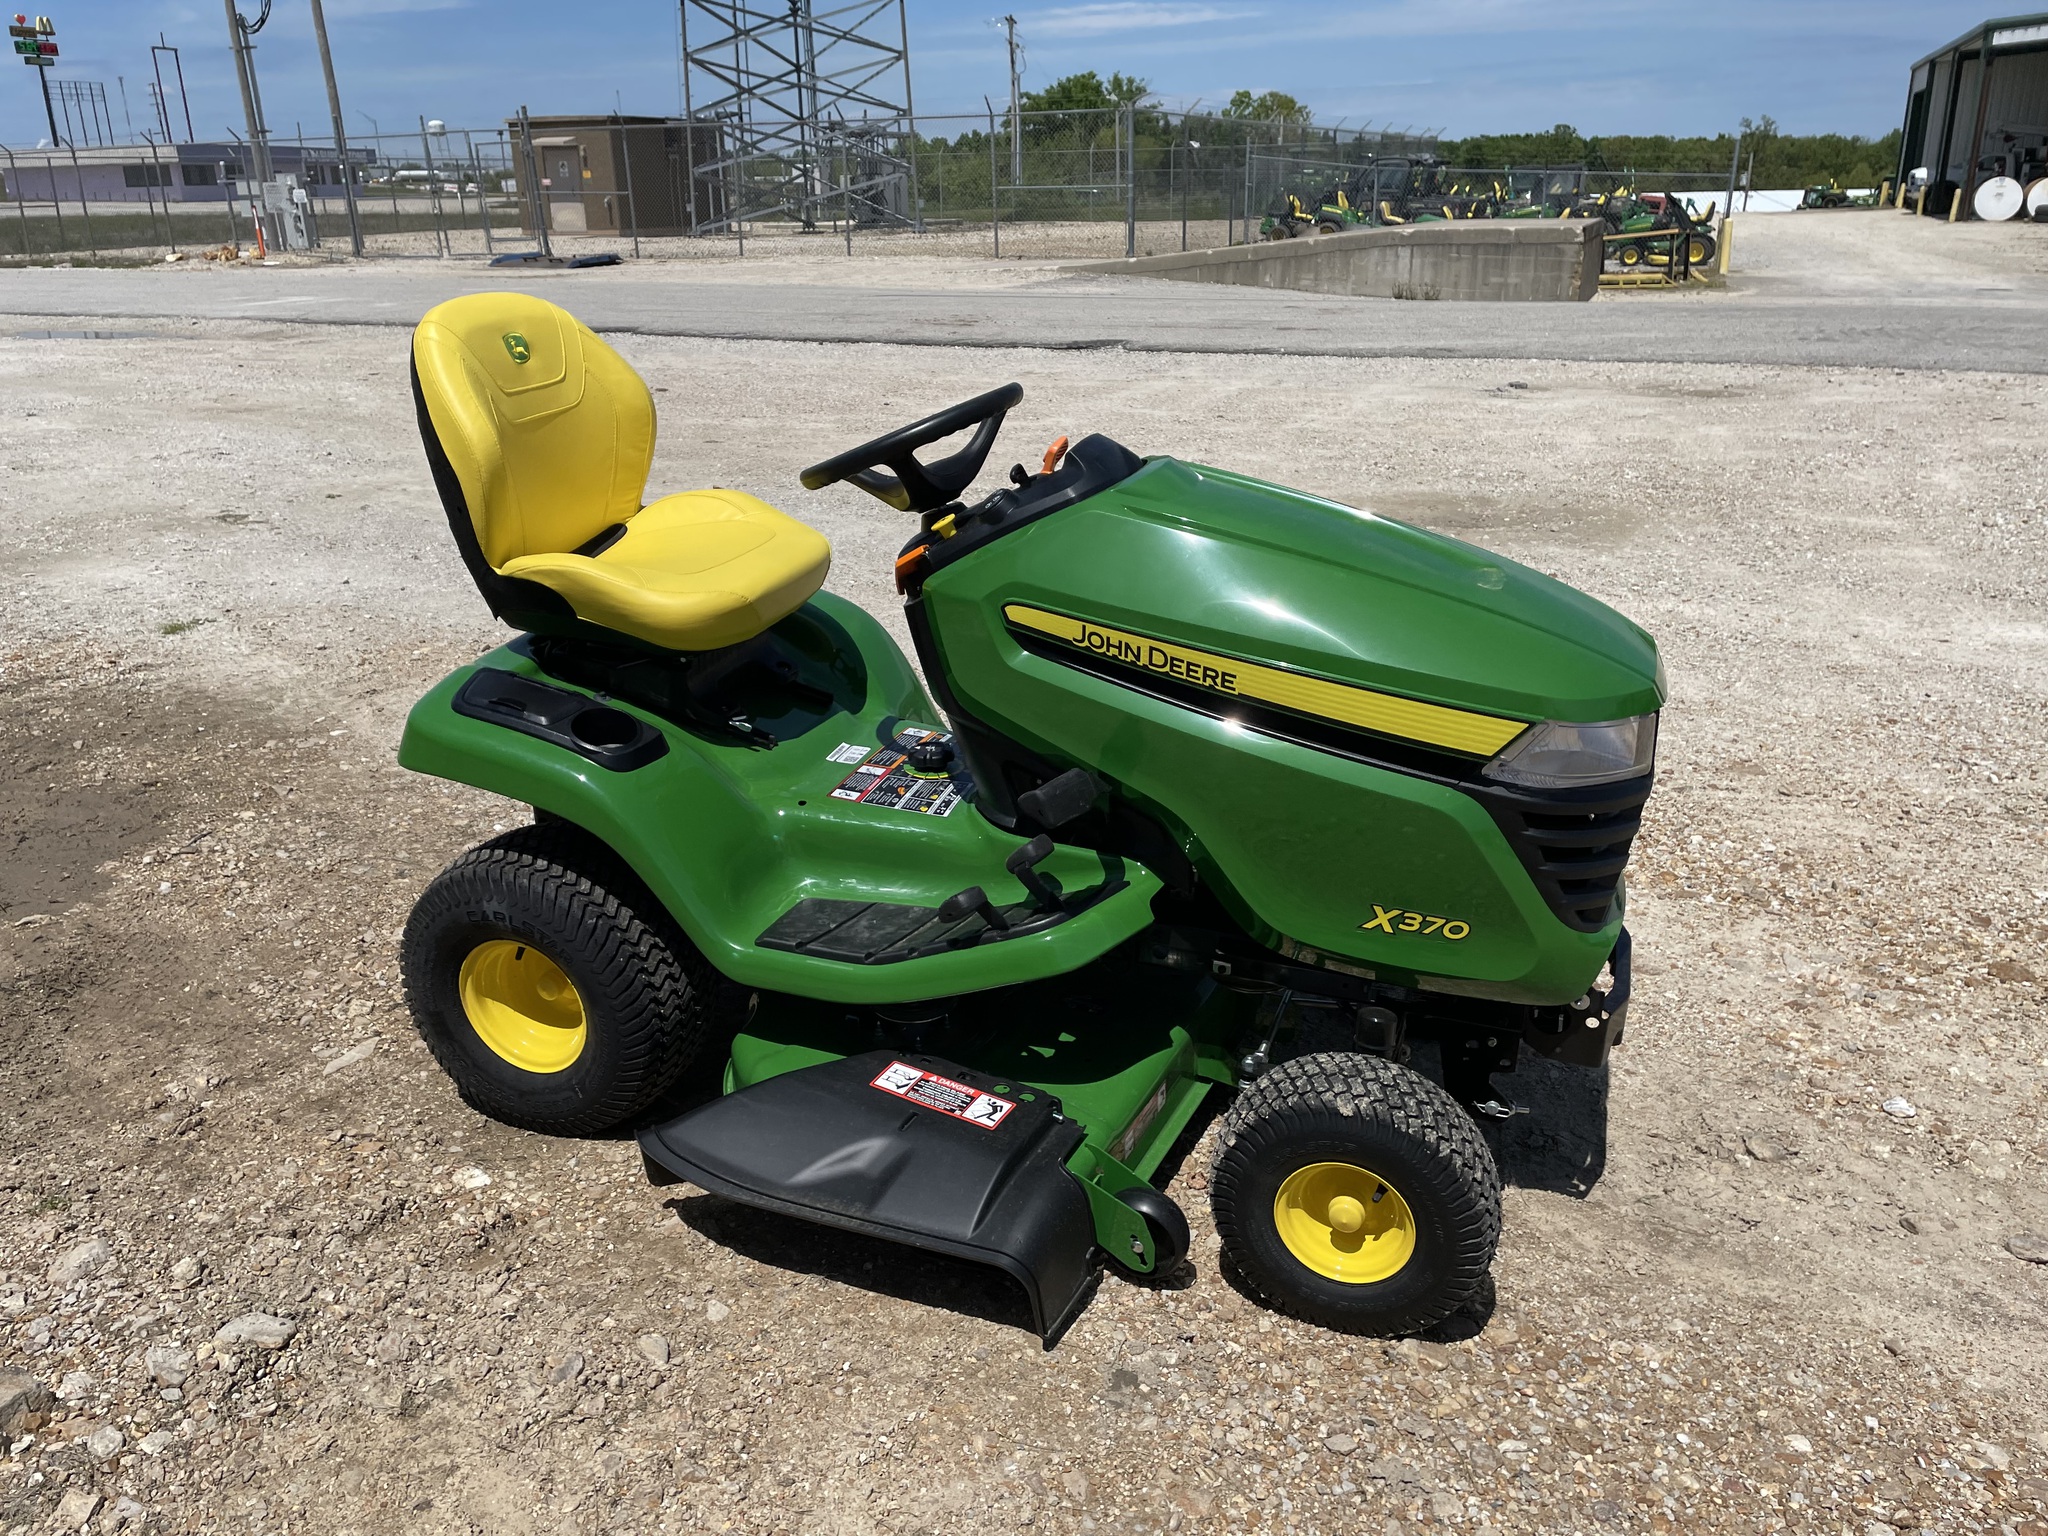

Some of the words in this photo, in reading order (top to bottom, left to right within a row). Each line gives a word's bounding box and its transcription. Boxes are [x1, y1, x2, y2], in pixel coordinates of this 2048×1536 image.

[1072, 624, 1142, 663] JOHN
[1148, 645, 1238, 692] DEERE
[1360, 904, 1471, 940] X370
[937, 1077, 975, 1095] DANGER
